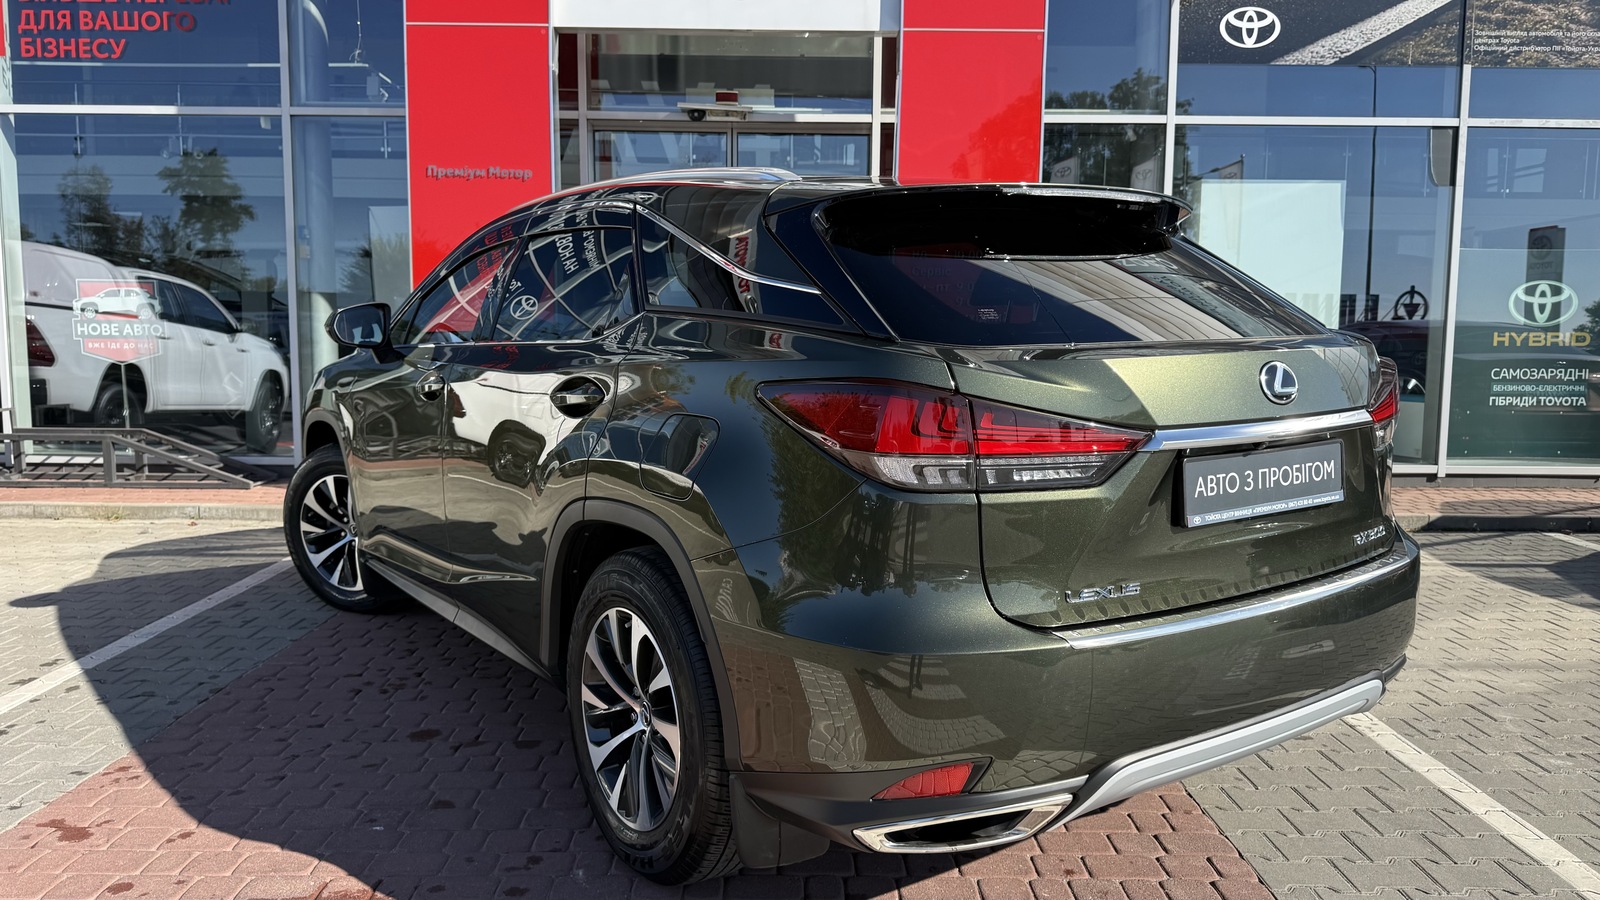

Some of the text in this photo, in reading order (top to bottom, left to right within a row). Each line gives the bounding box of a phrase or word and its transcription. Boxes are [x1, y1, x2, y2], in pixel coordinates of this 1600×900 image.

[17, 10, 195, 34] ДЛЯ ВАШОГО
[20, 37, 126, 59] БІЗНЕСУ
[1500, 37, 1520, 45] Toyota
[426, 164, 533, 182] Преміум Мотор
[77, 322, 163, 336] НОВЕ АВТО
[107, 341, 121, 349] ЇДЕ
[123, 342, 136, 350] ДО
[1492, 331, 1591, 347] HYBRID
[1490, 367, 1589, 381] САМОЗАРЯДНІ
[1492, 384, 1585, 392] БЕНЗИНОВО-ЕЛЕКТРИЧНІ
[1489, 396, 1587, 407] ГІБРИДИ TOYOTA
[1194, 471, 1240, 498] АВТО
[1258, 459, 1335, 490] ПРОБІГОМ
[1064, 582, 1141, 604] LEXUS
